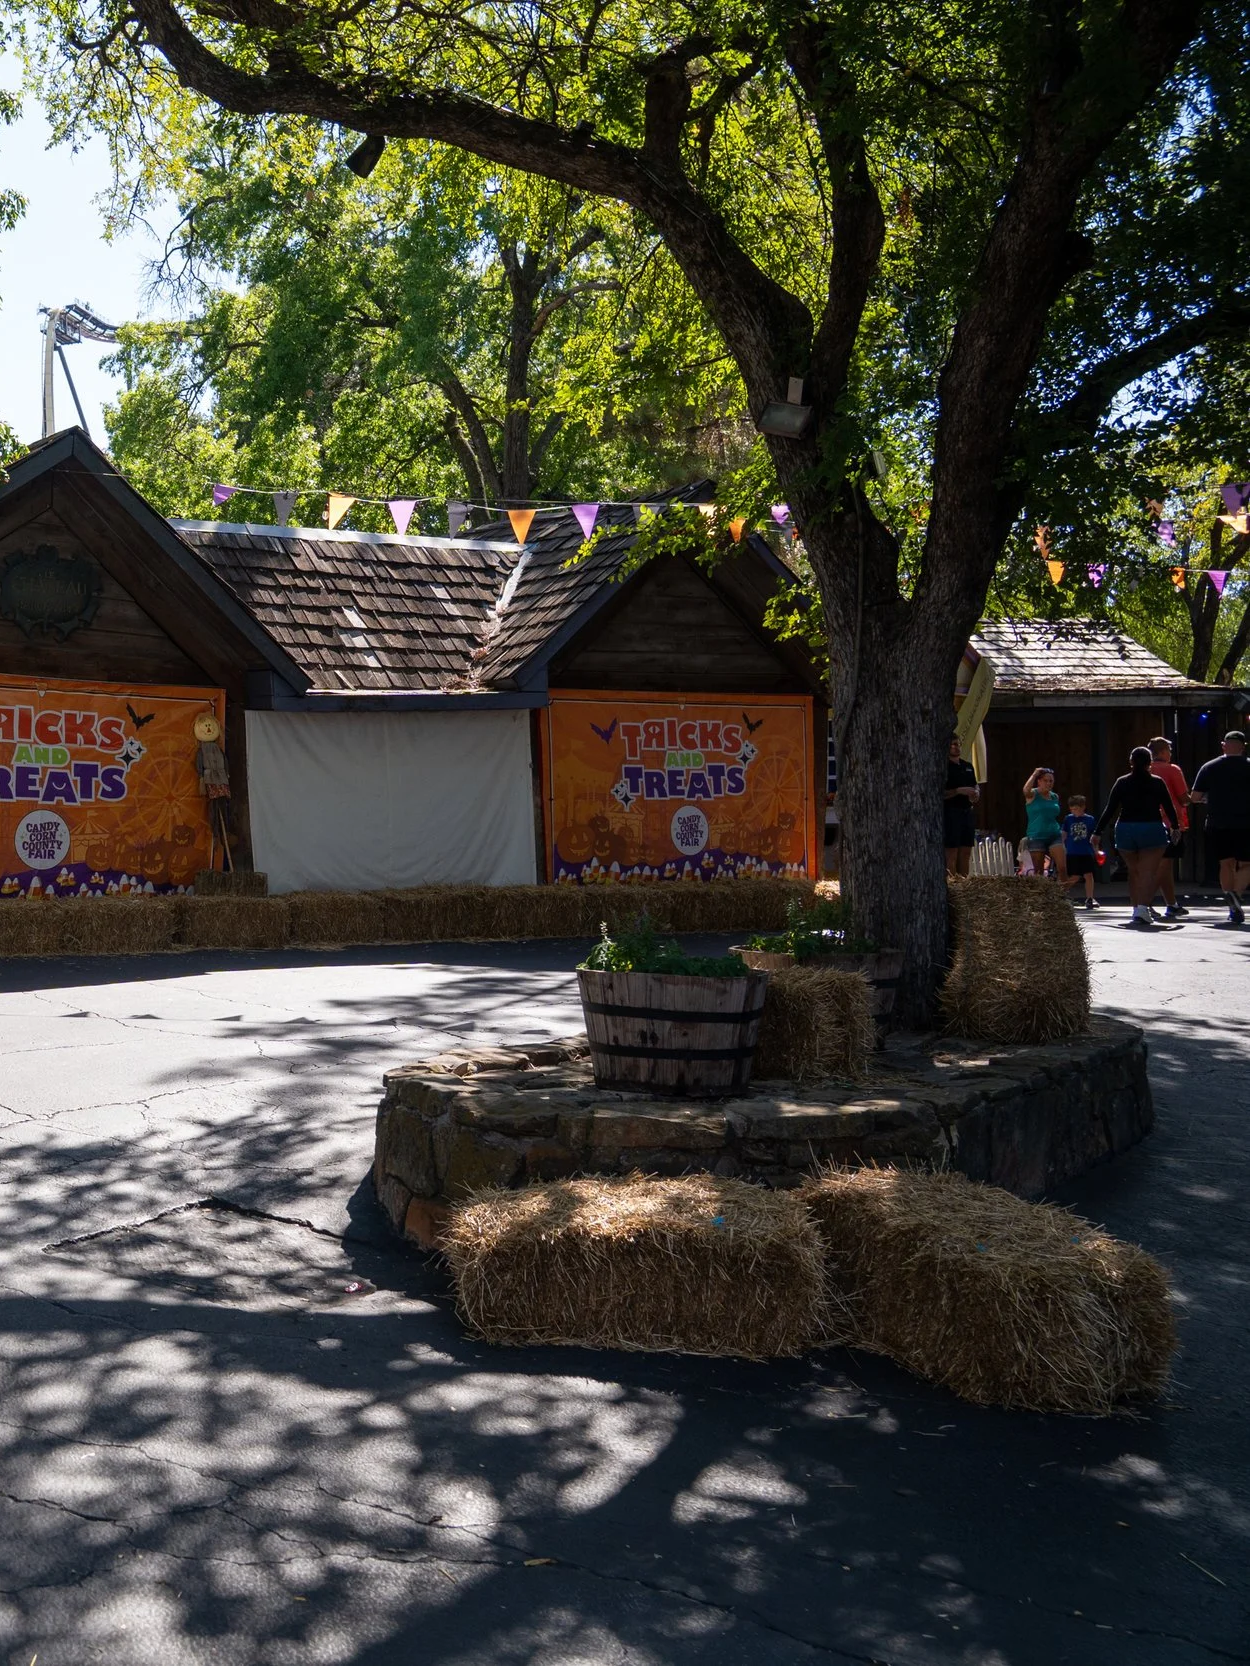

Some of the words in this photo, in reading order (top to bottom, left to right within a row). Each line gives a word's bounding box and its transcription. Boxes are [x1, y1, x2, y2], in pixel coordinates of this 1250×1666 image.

[620, 718, 742, 759] TRICKS
[12, 744, 69, 766] AND
[665, 751, 704, 768] AND
[622, 763, 746, 800] TREATS
[677, 815, 701, 825] CANDY
[26, 822, 60, 833] CANDY
[680, 823, 699, 832] CORN
[29, 831, 57, 842] CORN
[676, 830, 704, 840] COUNTY
[22, 840, 63, 852] COUNTY
[681, 838, 699, 847] FAIR
[28, 849, 55, 859] FAIR
